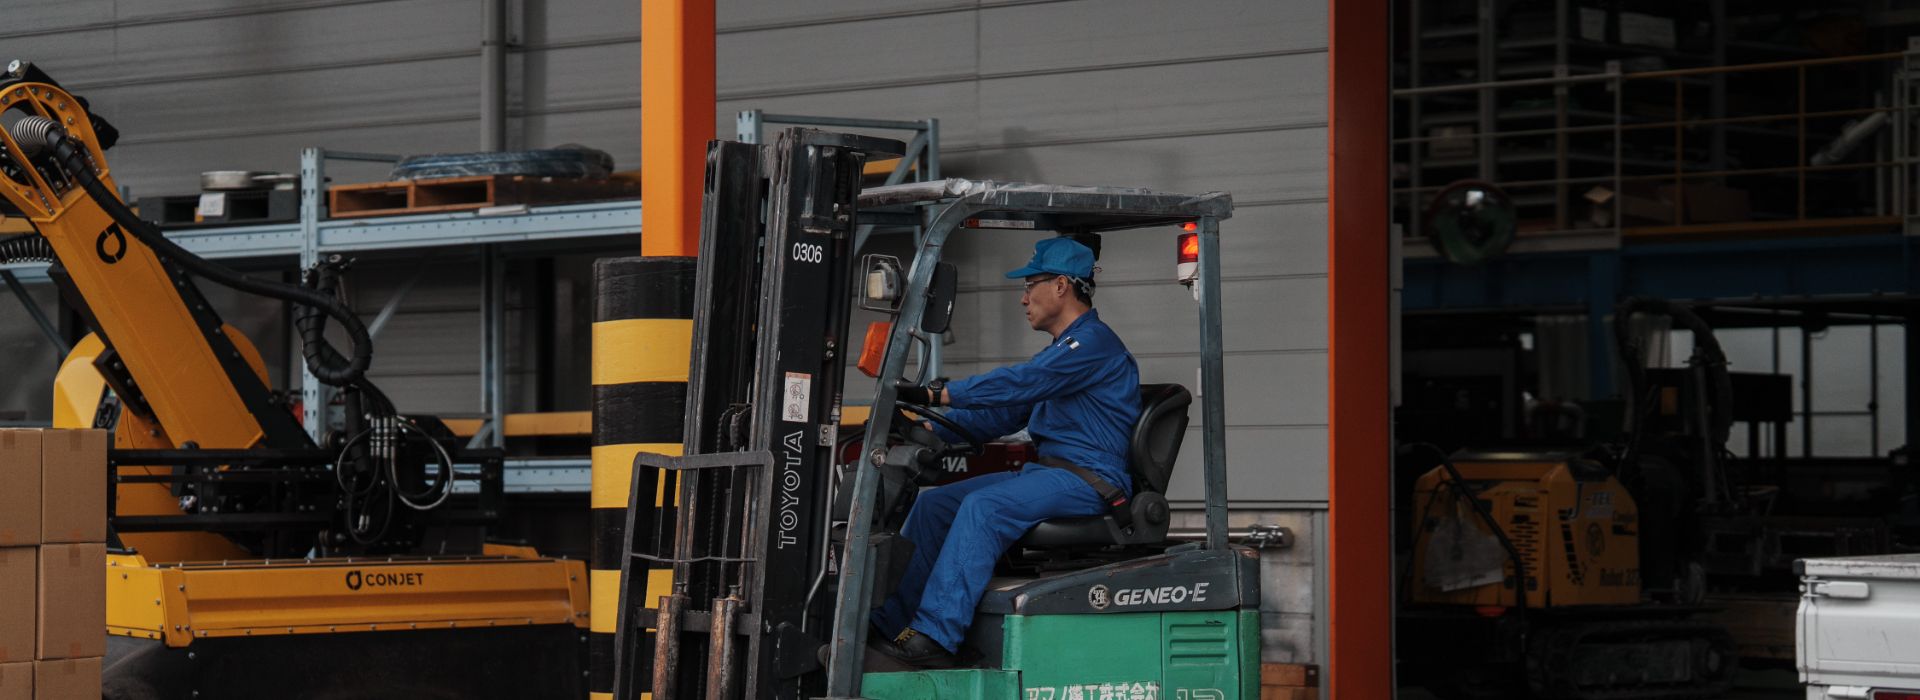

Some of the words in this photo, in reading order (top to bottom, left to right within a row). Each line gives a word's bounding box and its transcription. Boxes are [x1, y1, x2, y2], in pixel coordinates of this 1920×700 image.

[792, 242, 823, 264] 0306
[777, 430, 804, 549] TOYOTA
[365, 572, 424, 587] CONJET
[1113, 582, 1210, 606] GENEO-E
